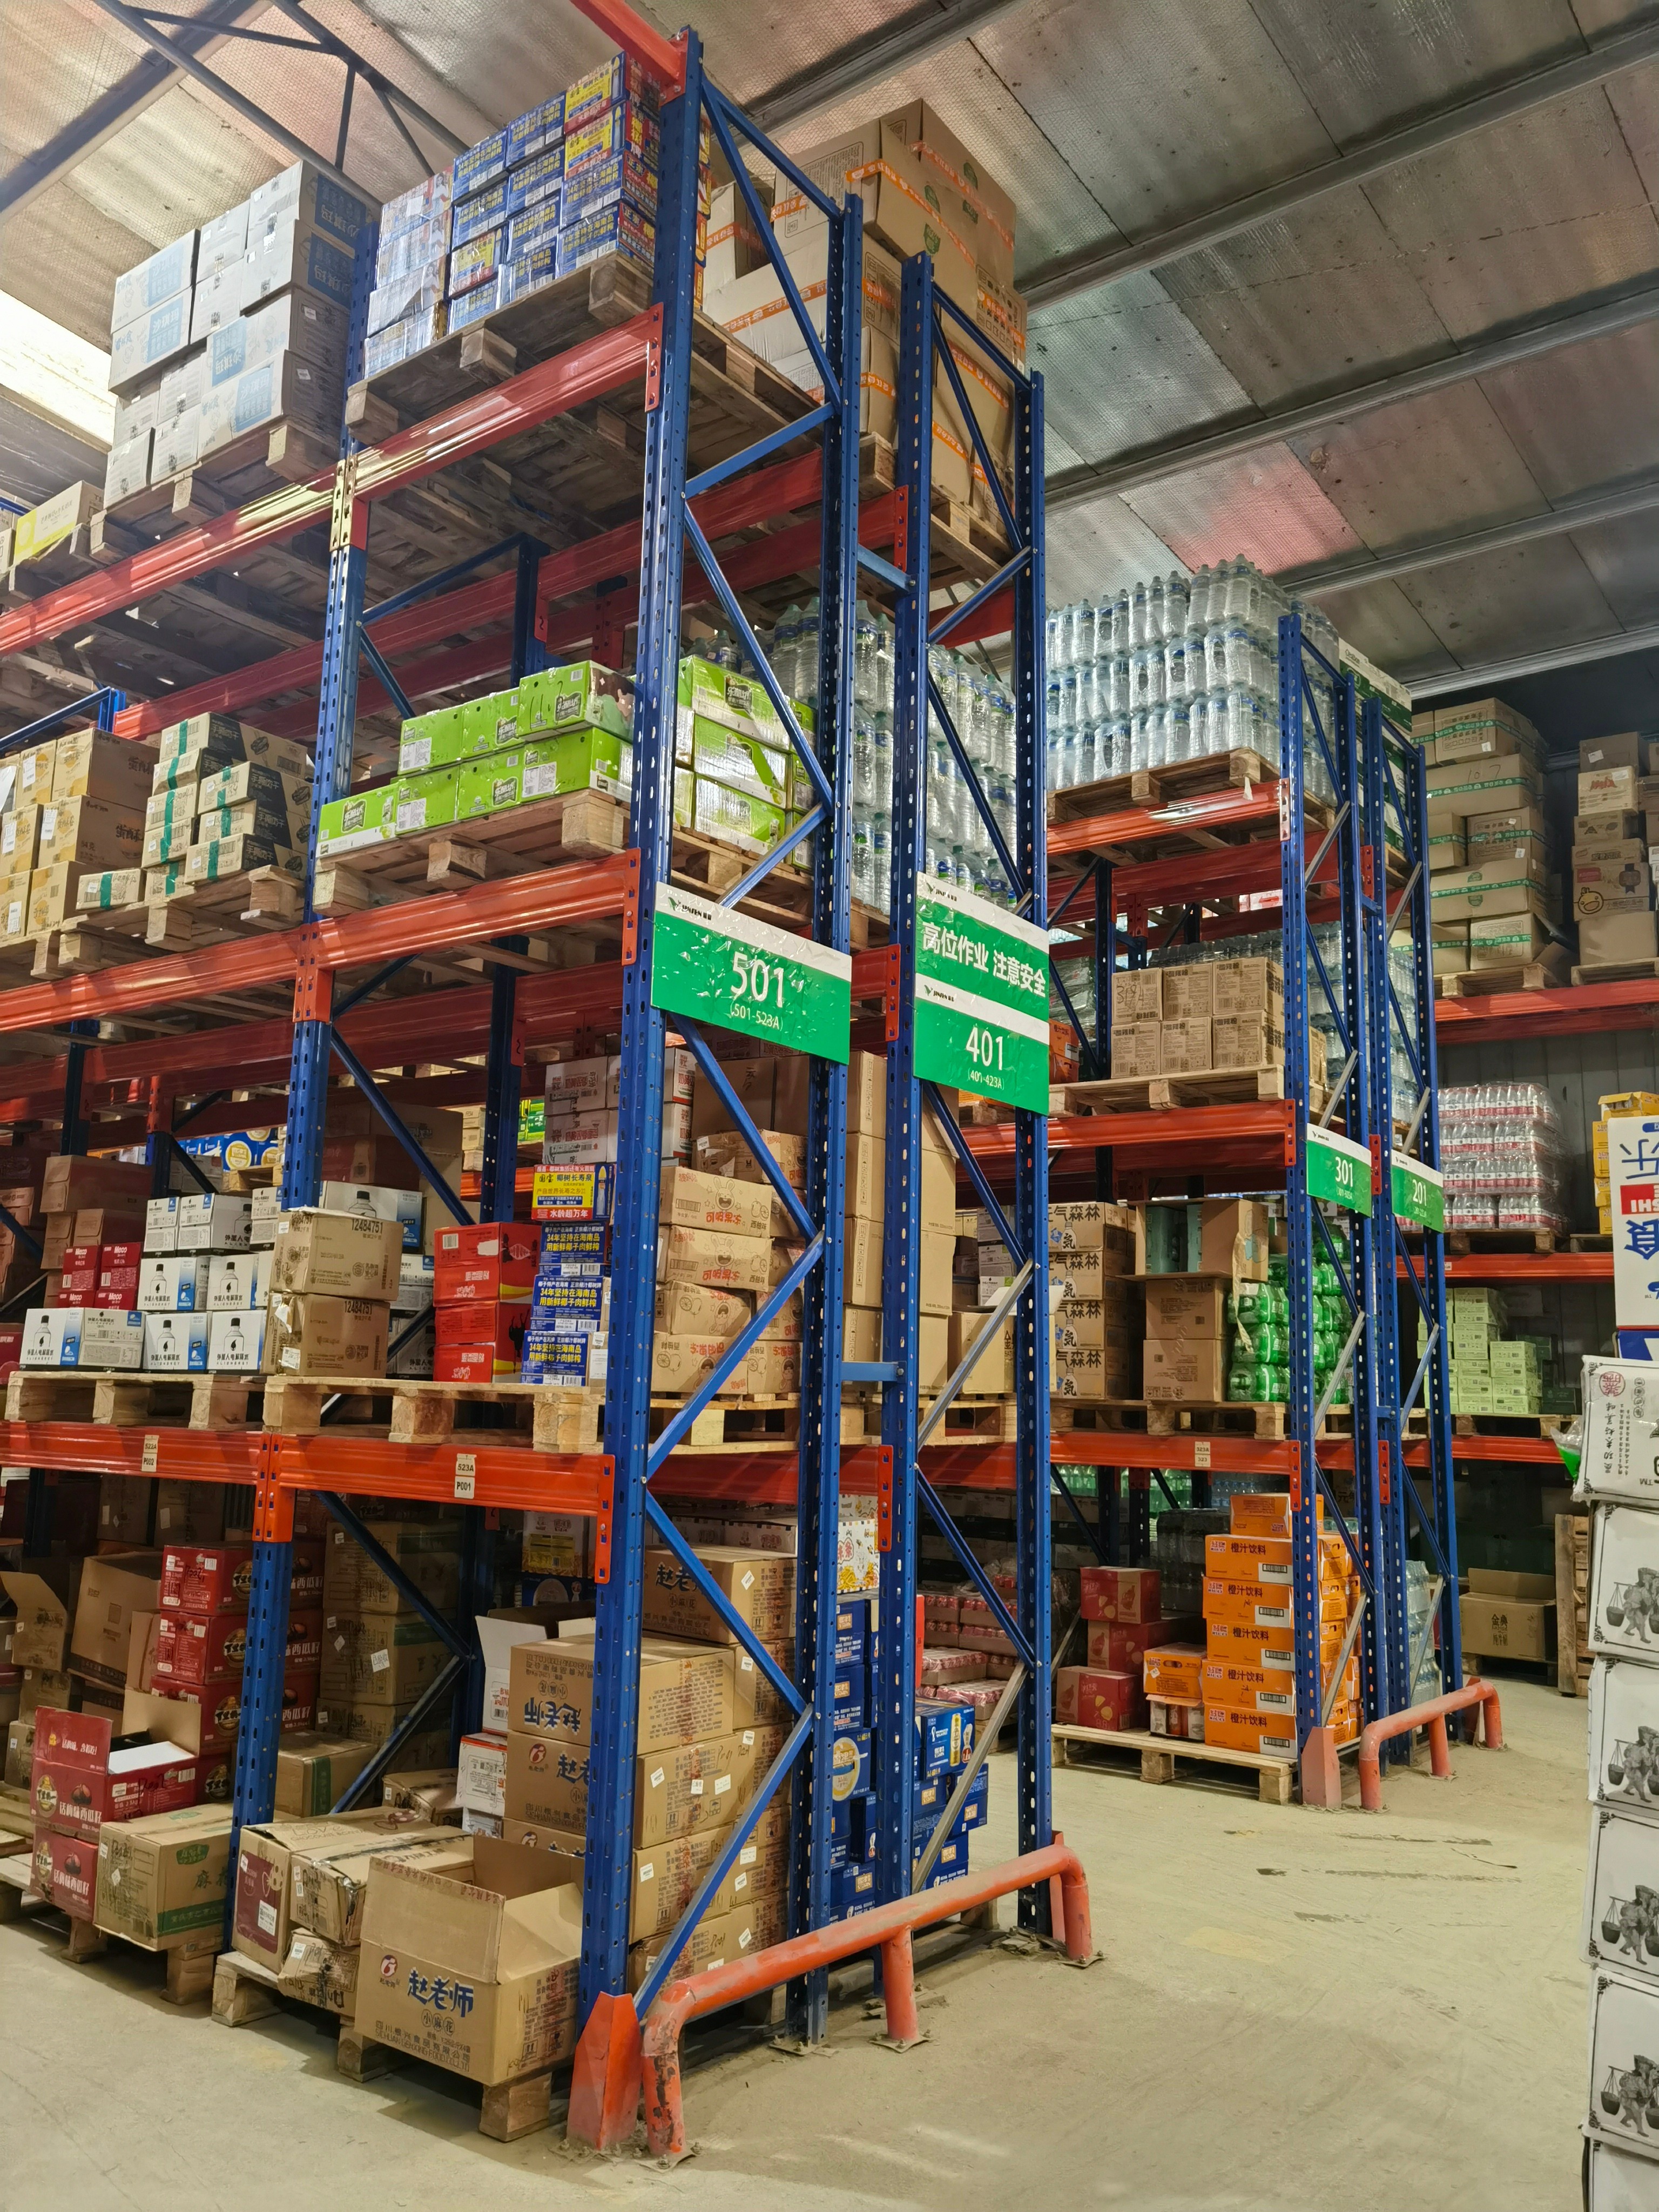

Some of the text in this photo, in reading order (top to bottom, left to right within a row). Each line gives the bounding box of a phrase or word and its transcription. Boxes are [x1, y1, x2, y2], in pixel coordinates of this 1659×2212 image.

[922, 921, 1046, 998] 高位作业 注意安全
[730, 950, 784, 1008] 501
[966, 1027, 1003, 1071] 401
[557, 1174, 592, 1182] 椰树长寿泉
[1335, 1156, 1353, 1188] 301
[1412, 1179, 1427, 1206] 201
[550, 1209, 589, 1218] 水龄超万年
[351, 1218, 383, 1233] 12484751
[547, 1233, 600, 1242] 34年坚持在海南岛
[546, 1243, 599, 1251] 用新鲜椰子肉鲜榨
[109, 1292, 122, 1300] Meco
[541, 1289, 597, 1298] 34年坚持在海南岛
[344, 1300, 373, 1315] 12484751
[539, 1297, 597, 1307] 用新鲜椰子肉鲜榨
[143, 1458, 154, 1466] P002
[457, 1464, 474, 1472] 523A
[456, 1481, 471, 1492] P001
[1231, 1542, 1266, 1555] 橙汁饮料
[1228, 1584, 1263, 1597] 橙汁饮料
[1232, 1627, 1269, 1641] 橙汁饮料
[1228, 1669, 1264, 1683] 橙汁饮料
[524, 1697, 582, 1736] 赵老师
[1230, 1715, 1267, 1727] 橙汁饮料
[408, 1966, 474, 2018] 赵老师
[421, 2008, 455, 2036] 小麻花
